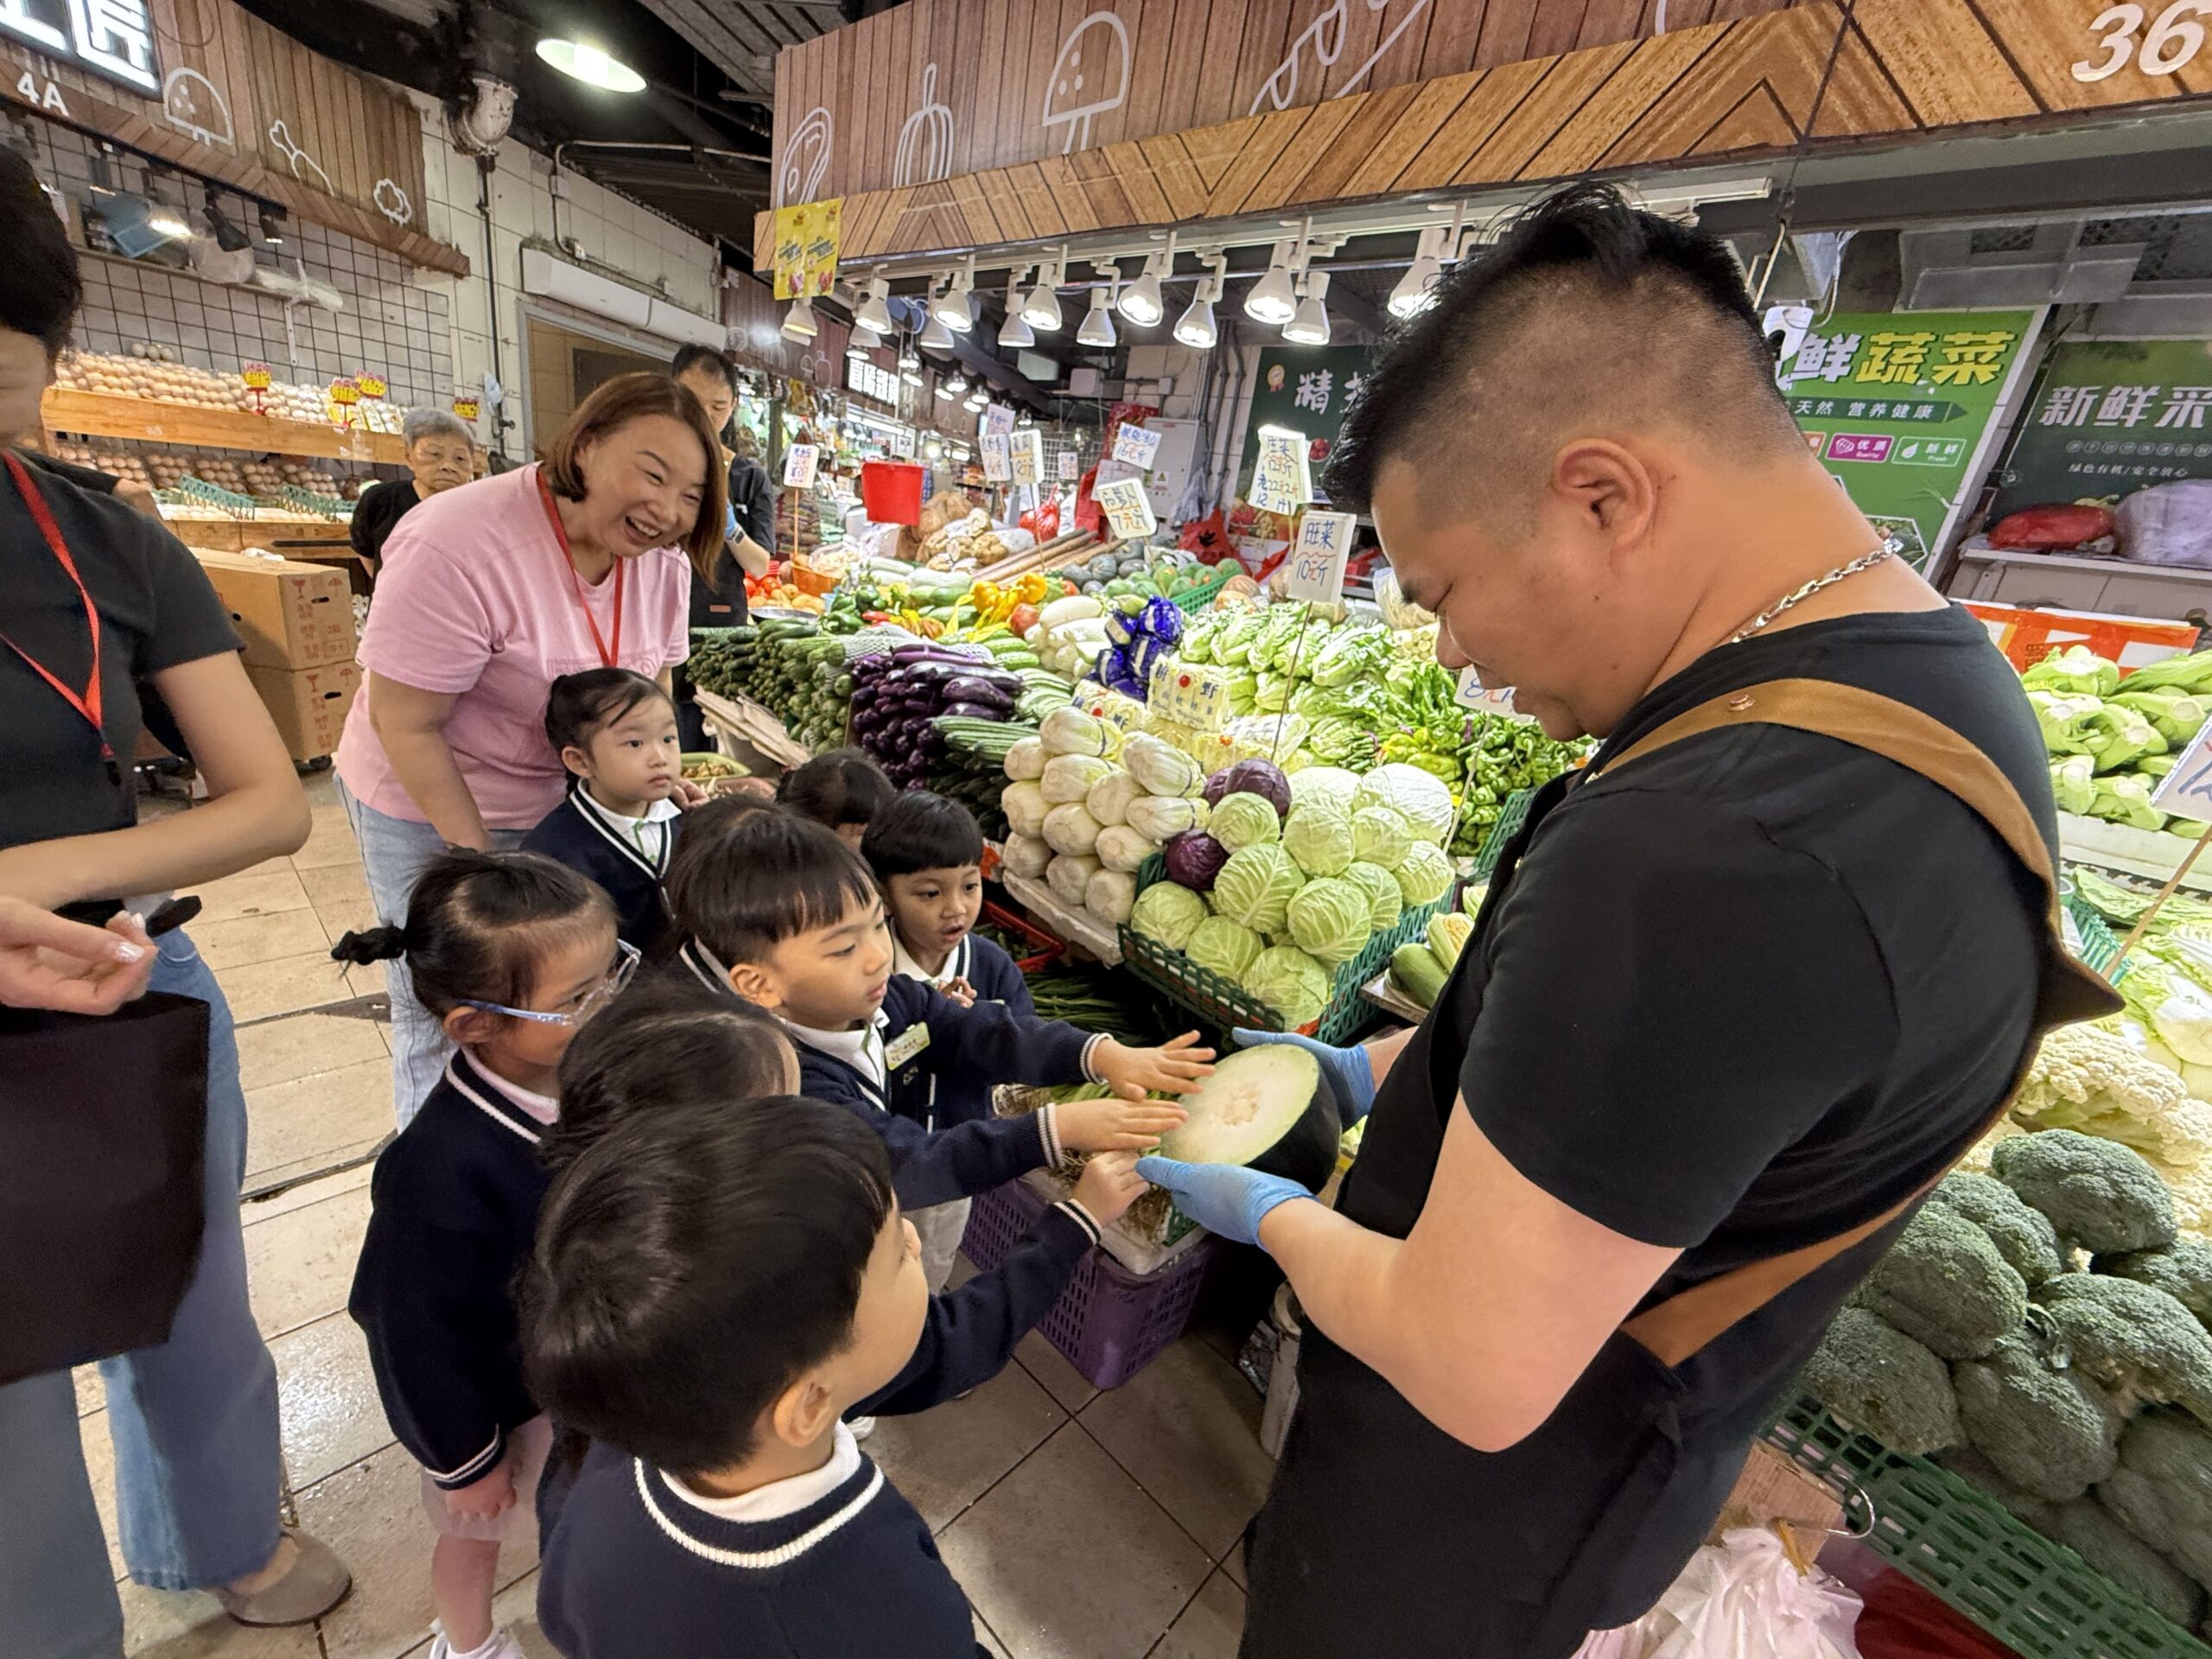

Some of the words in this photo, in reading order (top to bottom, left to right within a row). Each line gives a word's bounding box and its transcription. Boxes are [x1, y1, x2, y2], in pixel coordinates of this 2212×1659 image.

[2071, 0, 2212, 82] 36
[17, 72, 69, 117] 4A
[1776, 331, 2016, 388] 鲜蔬菜
[1795, 400, 1834, 415] 天然
[1847, 402, 1935, 419] 营养健康
